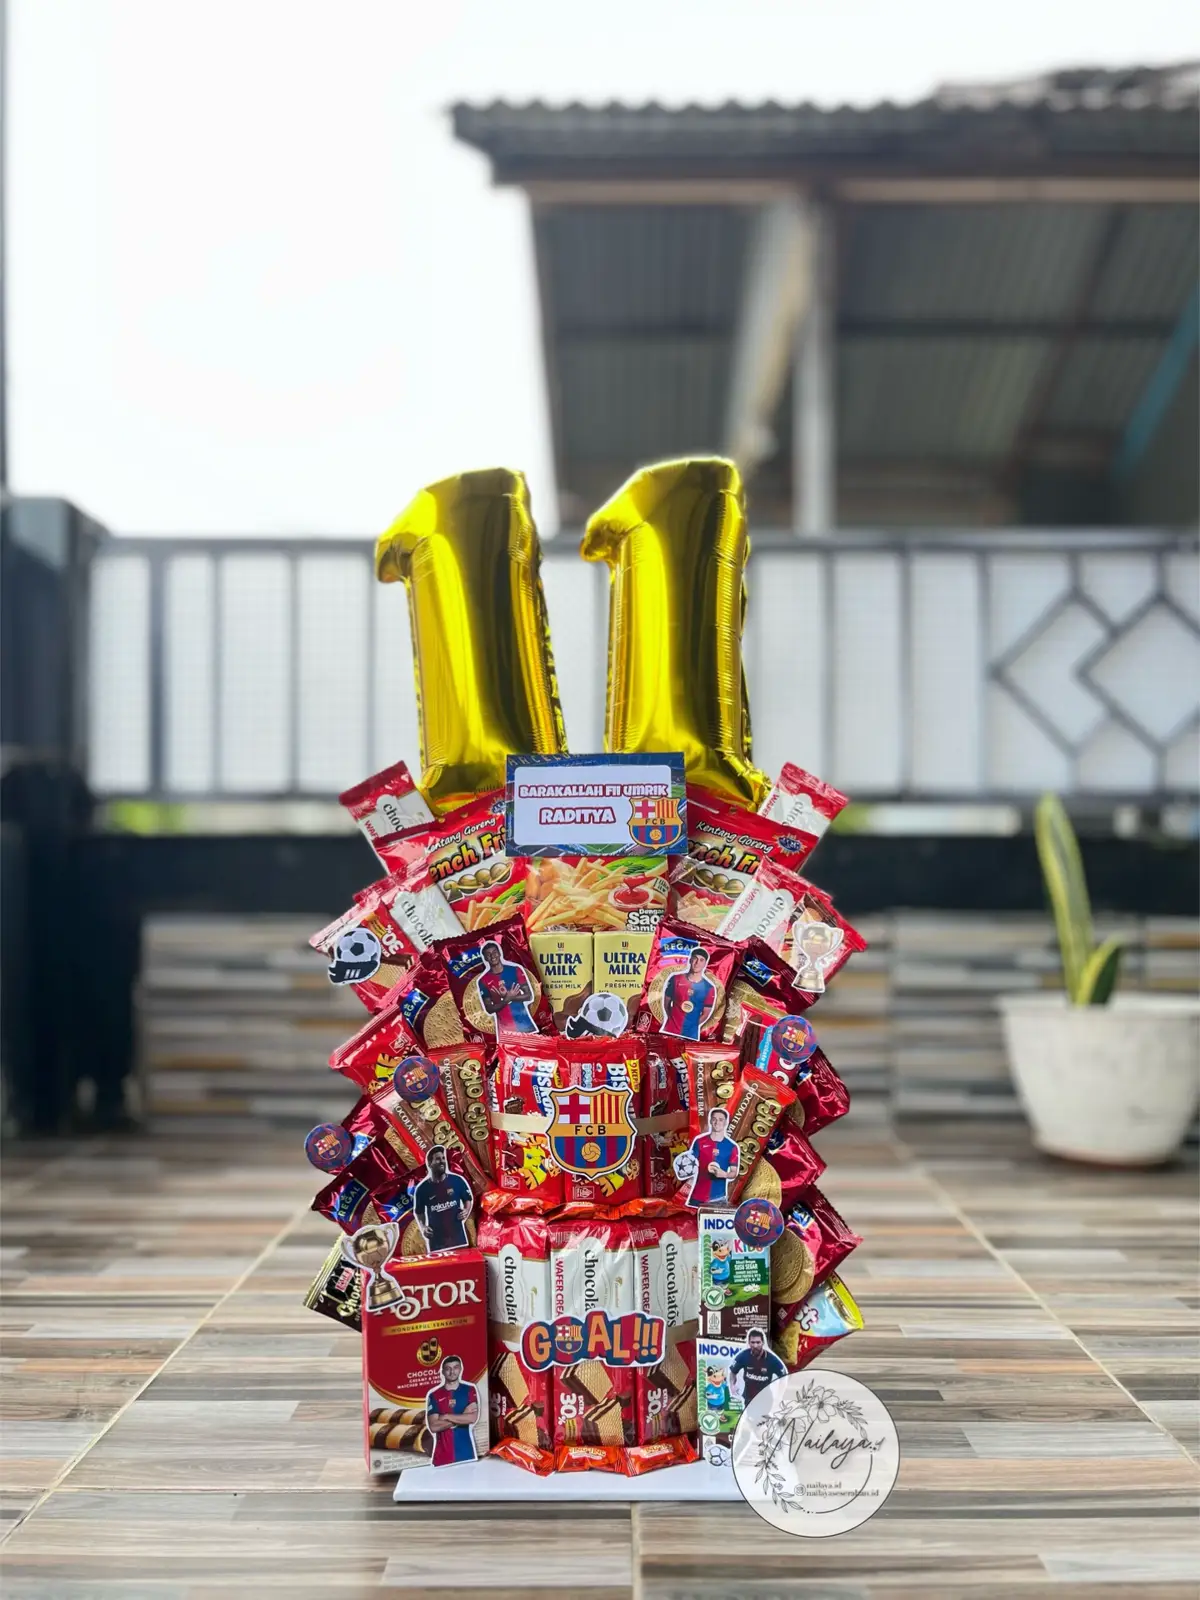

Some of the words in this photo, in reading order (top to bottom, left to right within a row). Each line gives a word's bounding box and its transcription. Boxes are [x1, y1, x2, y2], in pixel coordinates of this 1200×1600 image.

[519, 785, 602, 798] BARAKALLAH
[540, 807, 616, 824] RADITYA
[464, 818, 496, 835] Goreng
[696, 821, 737, 843] Kentang
[738, 835, 773, 854] Goreng
[429, 841, 480, 880] ench
[402, 901, 434, 946] chocola
[628, 912, 664, 925] Sao
[755, 896, 785, 938] chocol
[539, 953, 582, 964] ULTRA
[603, 952, 646, 963] ULTRA
[545, 965, 577, 976] MILK
[608, 964, 641, 975] MILK
[574, 1125, 606, 1135] FCB
[338, 1186, 361, 1217] REGAL
[704, 1219, 735, 1230] INDO
[584, 1249, 599, 1312] chocola
[640, 1254, 650, 1290] WAFER
[372, 1279, 482, 1320] STOR
[504, 1256, 520, 1326] chocolat
[733, 1305, 759, 1315] COKELAT
